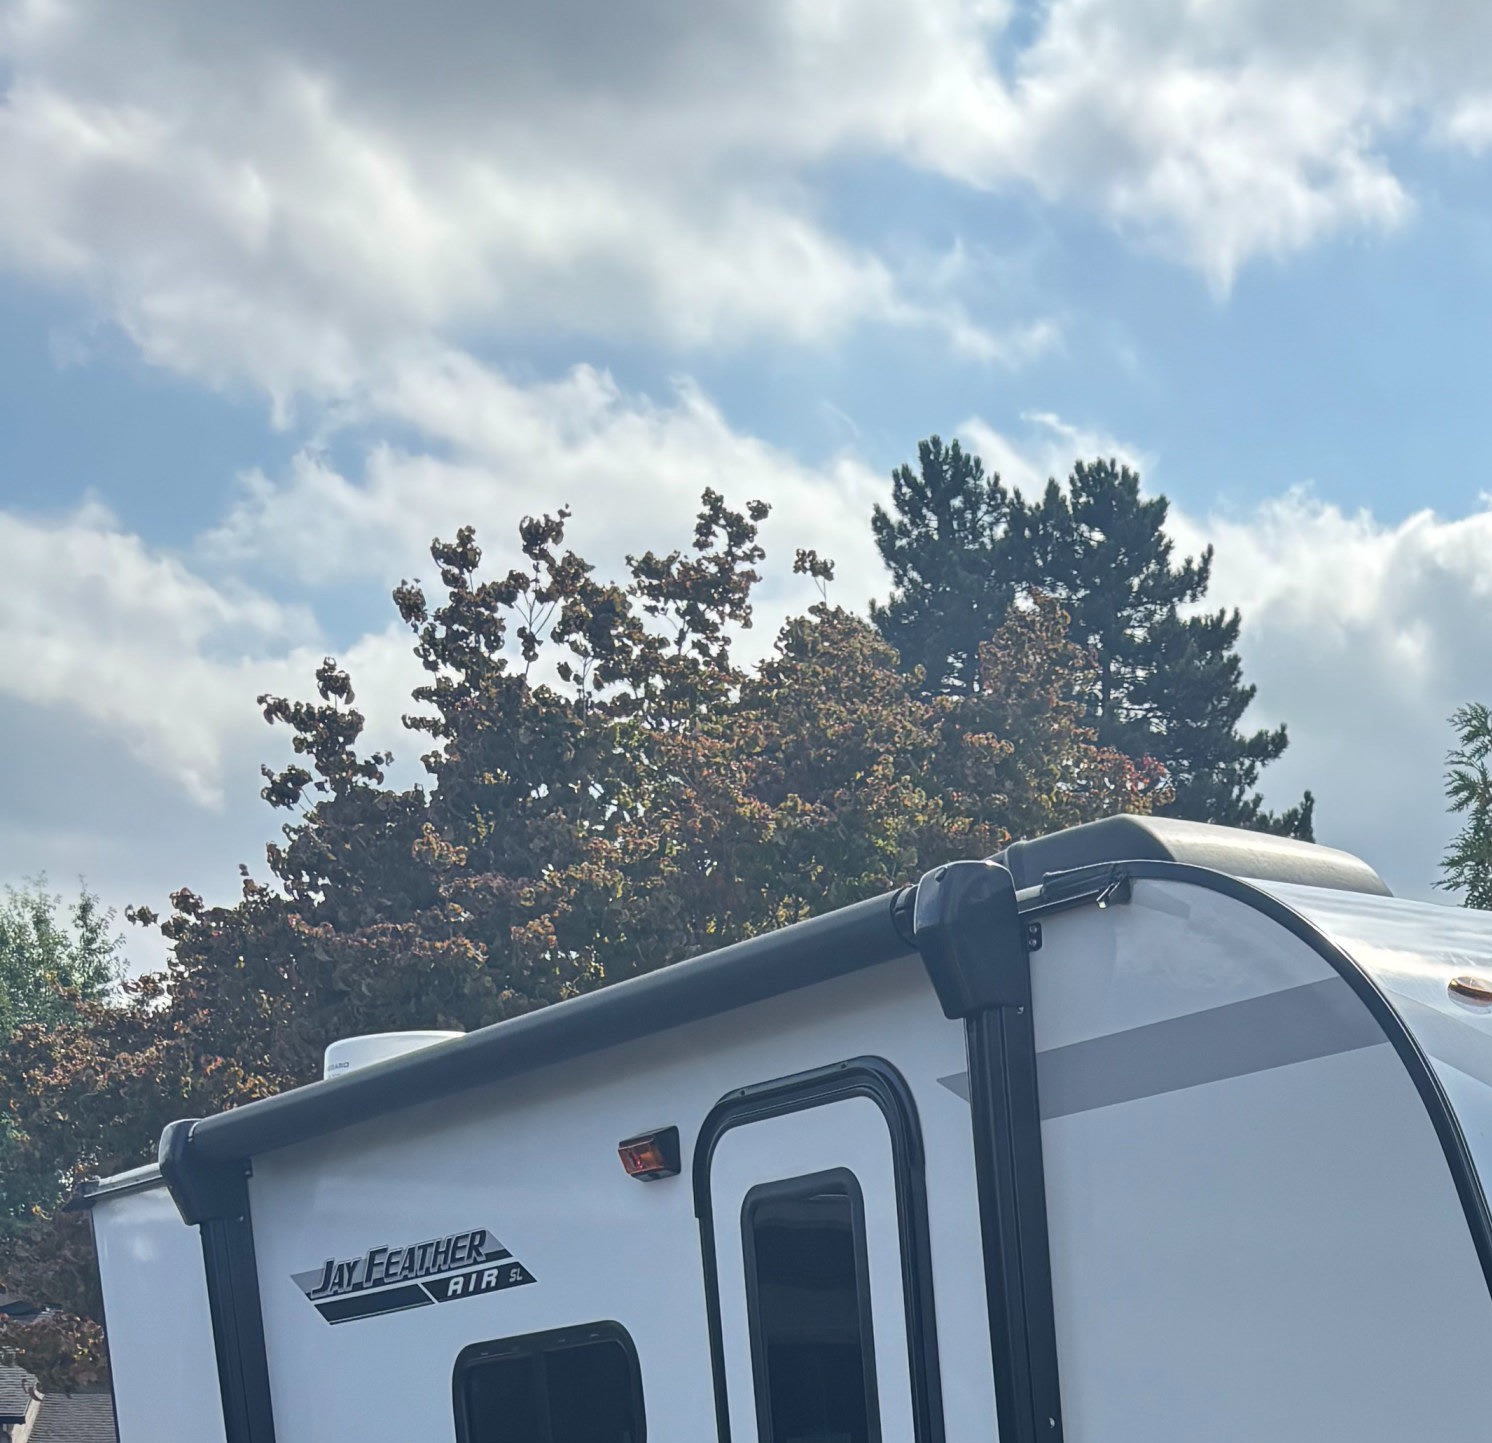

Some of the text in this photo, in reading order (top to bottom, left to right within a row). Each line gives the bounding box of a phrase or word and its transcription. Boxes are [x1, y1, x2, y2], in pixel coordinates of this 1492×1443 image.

[311, 1227, 487, 1299] JAY FEATHER
[447, 1268, 523, 1297] AIR SL
